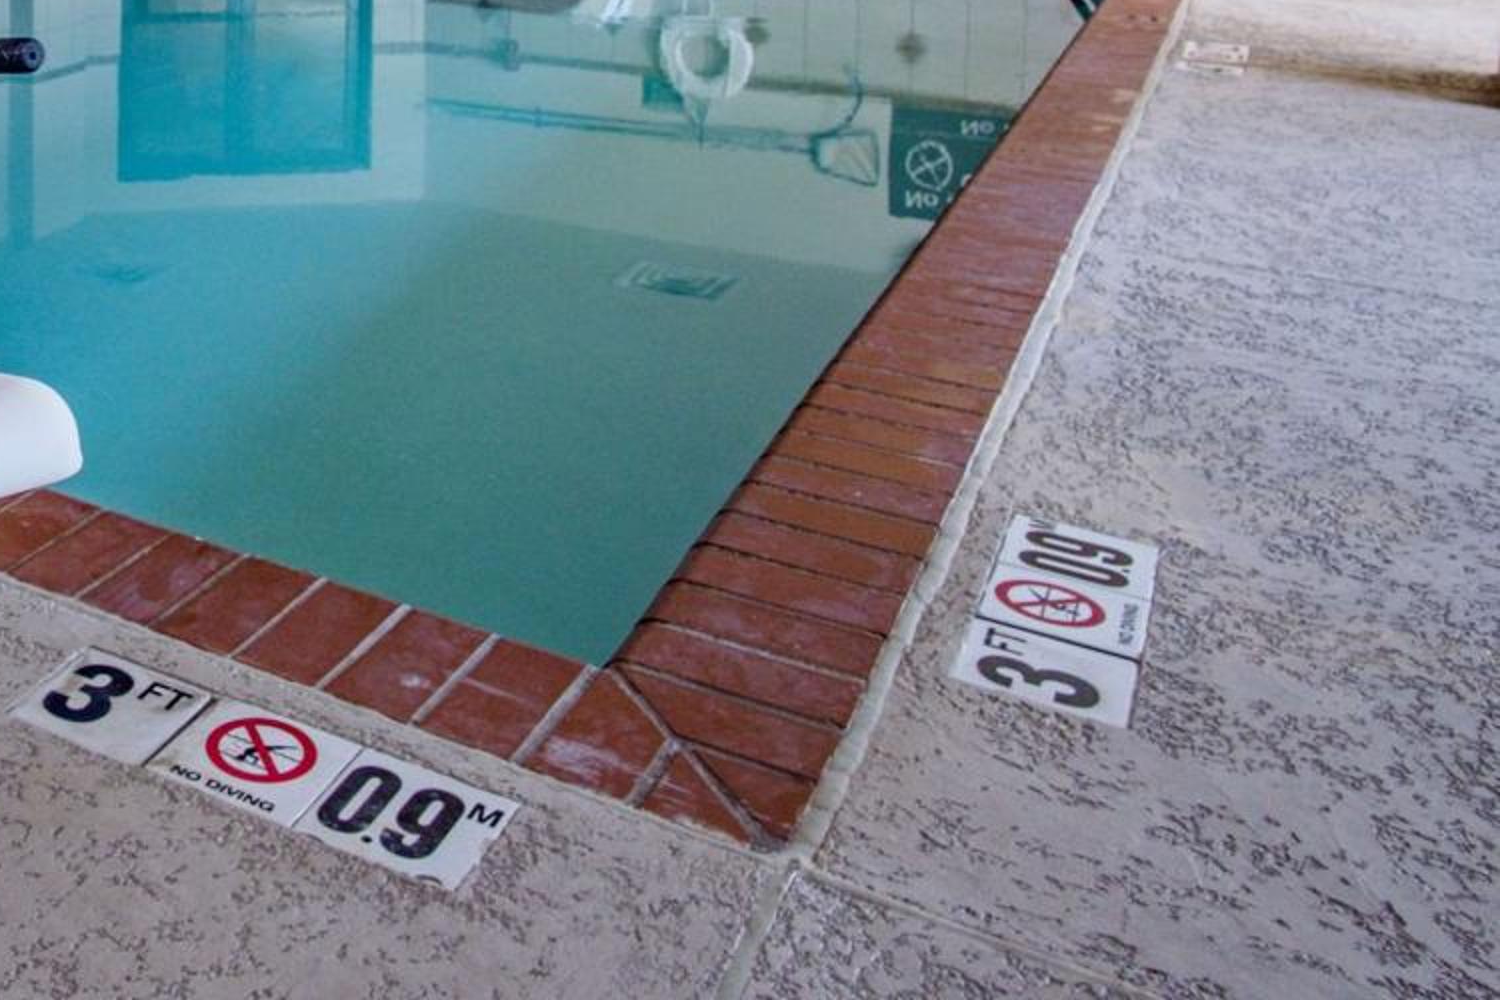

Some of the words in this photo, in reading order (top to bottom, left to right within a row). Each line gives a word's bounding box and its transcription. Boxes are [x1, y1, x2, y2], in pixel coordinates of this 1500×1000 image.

[983, 627, 1028, 656] FT
[42, 664, 135, 723] 3
[136, 681, 194, 714] FT
[976, 655, 1102, 709] 3
[169, 764, 202, 783] NO
[204, 777, 276, 812] DIVING
[317, 765, 466, 860] 0.9
[467, 802, 506, 829] M
